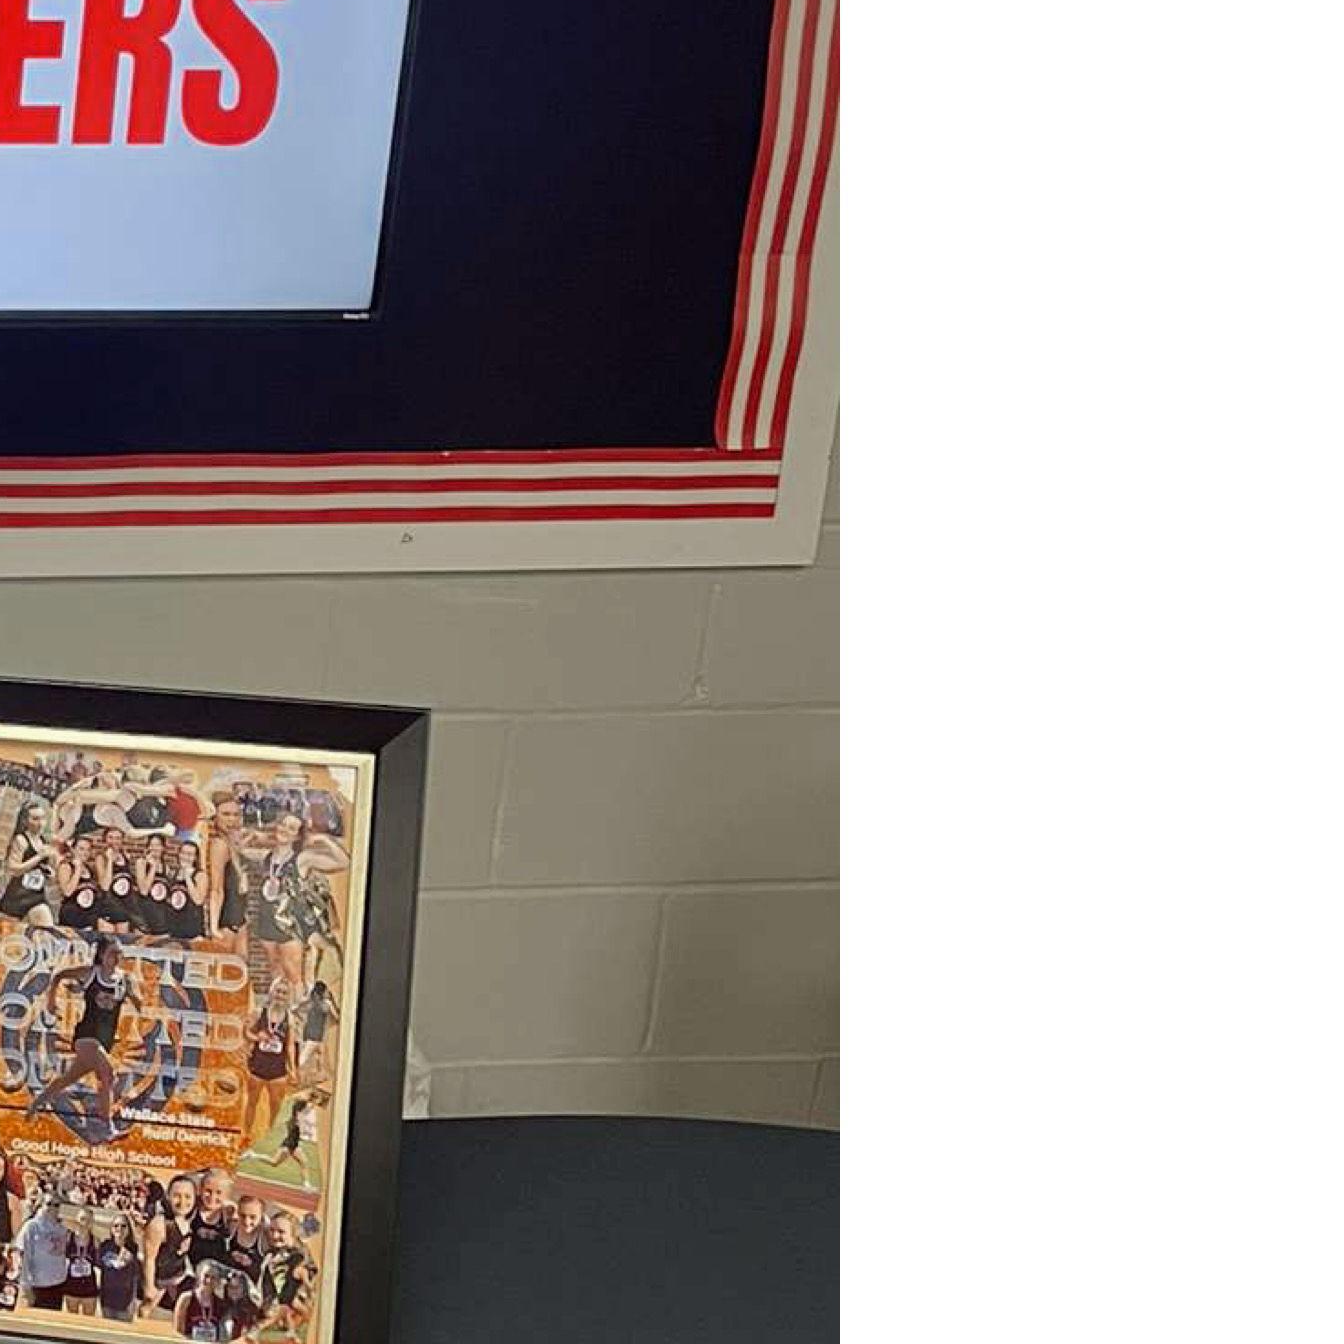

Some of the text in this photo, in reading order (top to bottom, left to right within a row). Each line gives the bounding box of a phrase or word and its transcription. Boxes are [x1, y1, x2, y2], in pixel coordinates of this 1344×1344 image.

[11, 1137, 176, 1167] Good Hope High School
